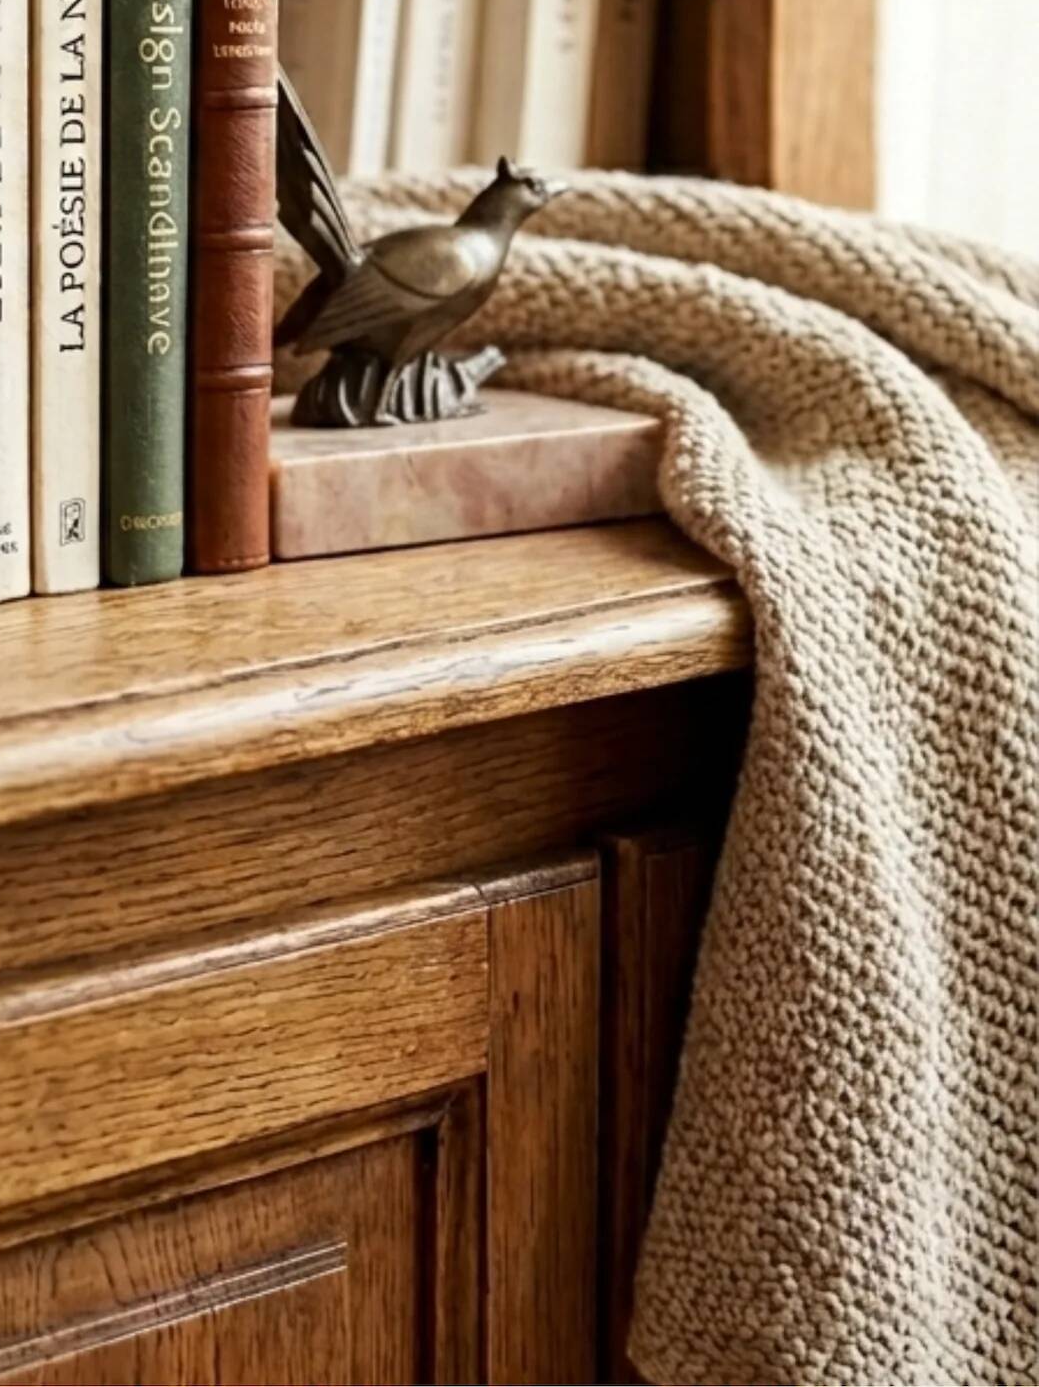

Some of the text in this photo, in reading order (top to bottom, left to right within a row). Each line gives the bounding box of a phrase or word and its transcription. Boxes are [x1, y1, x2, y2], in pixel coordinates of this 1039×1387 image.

[60, 34, 85, 83] LA
[60, 94, 86, 147] DE
[60, 304, 85, 353] LA
